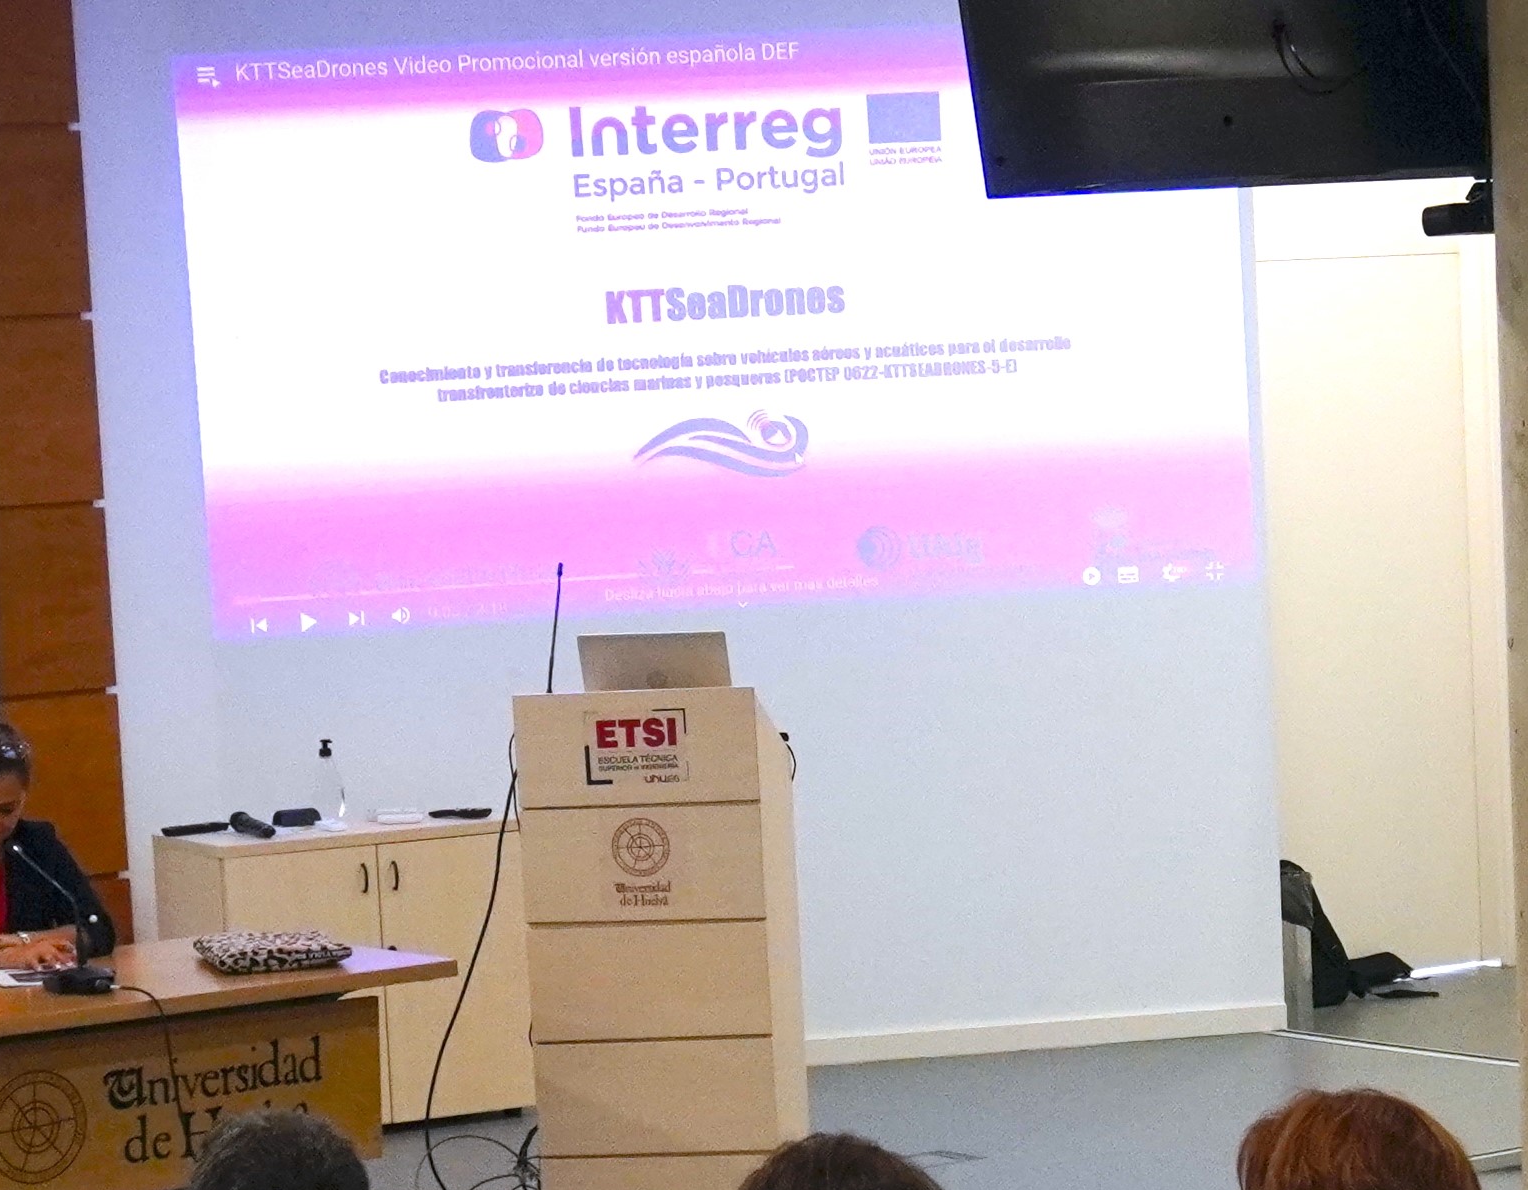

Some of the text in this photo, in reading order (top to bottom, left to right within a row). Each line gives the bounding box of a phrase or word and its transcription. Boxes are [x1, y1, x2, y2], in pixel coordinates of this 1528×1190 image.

[235, 41, 799, 82] KTTSeaDrones Video Promocional versión española DEF
[569, 105, 843, 158] Interreg
[573, 171, 684, 202] España
[715, 162, 846, 194] Portugal
[604, 284, 846, 325] KTTSeaDrones
[379, 365, 481, 385] Conocimiento
[484, 366, 492, 380] y
[496, 358, 593, 379] transferencia
[597, 357, 614, 372] de
[697, 350, 737, 368] sobre
[864, 346, 872, 360] y
[948, 341, 980, 356] para
[983, 338, 996, 354] el
[999, 335, 1071, 352] desarrollo
[438, 382, 544, 403] transfronterizo
[548, 380, 566, 396] de
[569, 377, 630, 395] ciencias
[634, 375, 692, 391] marinas
[695, 375, 703, 390] y
[706, 371, 781, 389] pesqueras
[595, 717, 677, 748] ETSI
[597, 753, 679, 765] ESCUELA TÉCNICA
[620, 894, 633, 906] de
[103, 1035, 322, 1110] Universidad
[124, 1114, 172, 1163] de
